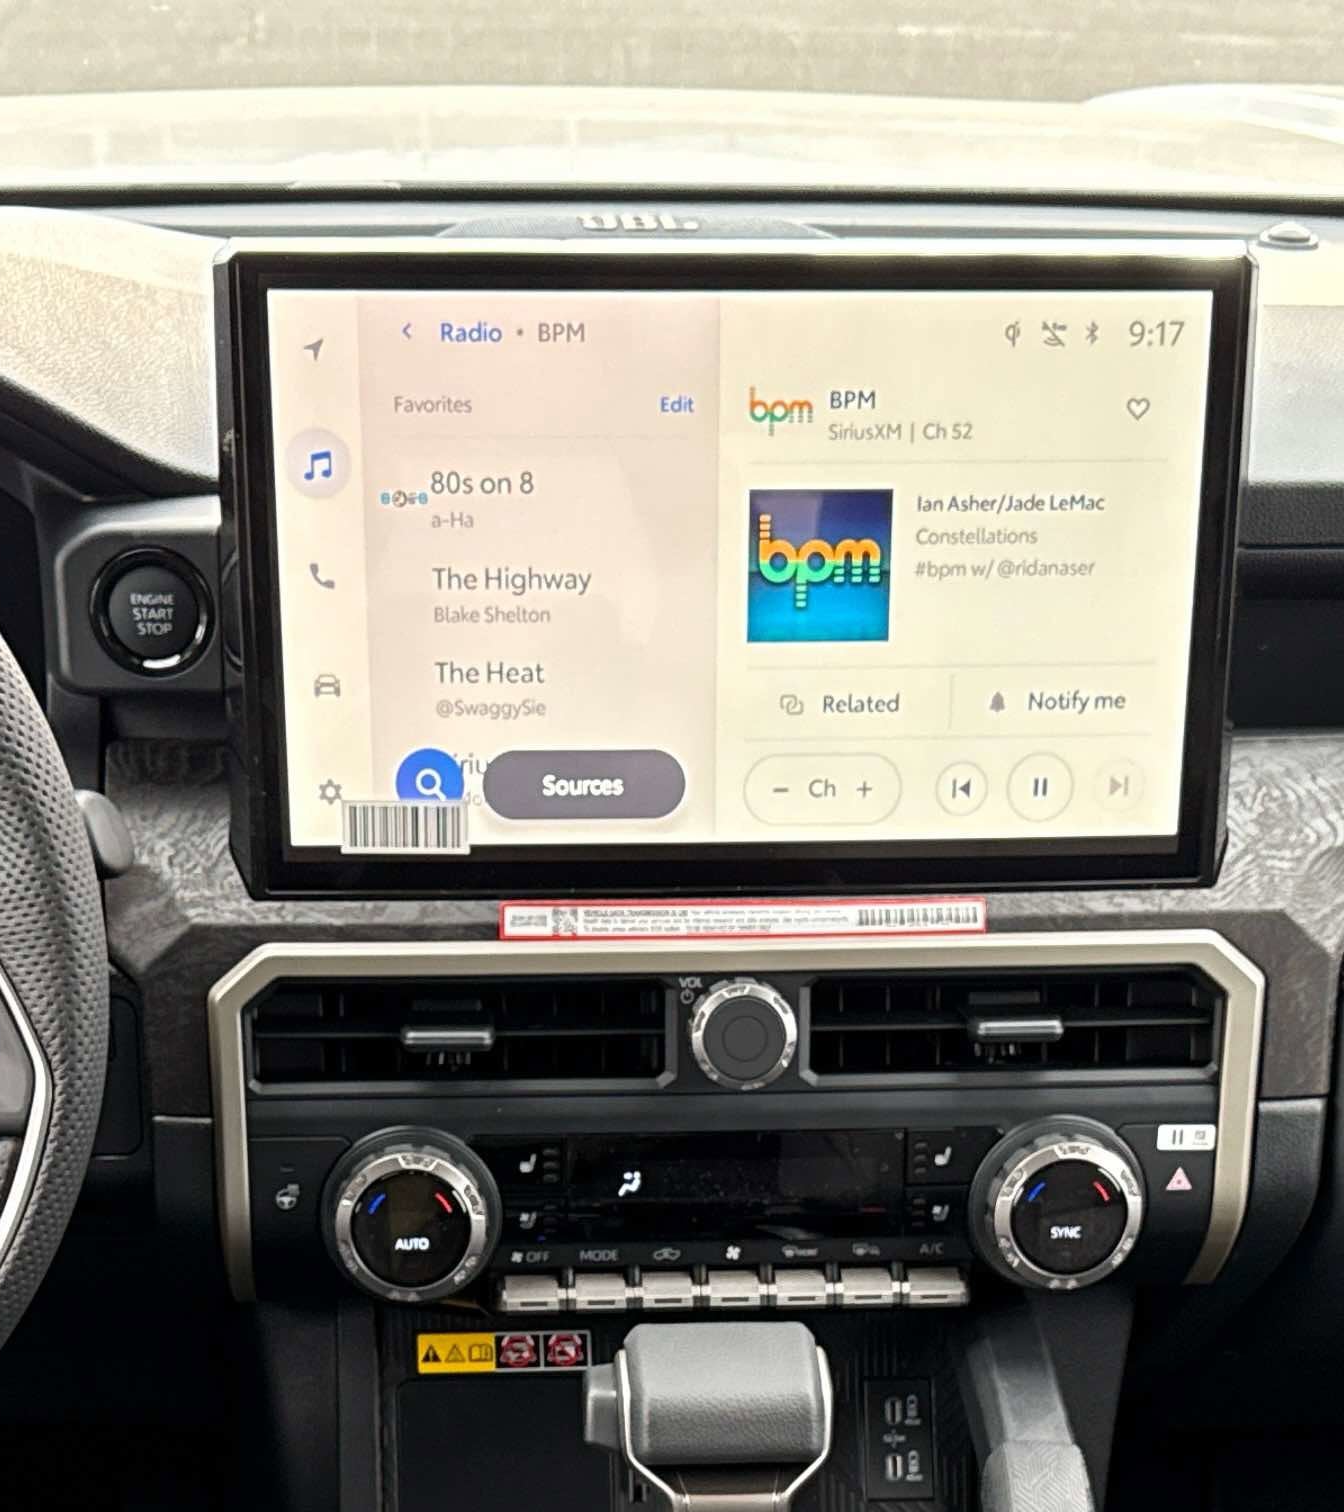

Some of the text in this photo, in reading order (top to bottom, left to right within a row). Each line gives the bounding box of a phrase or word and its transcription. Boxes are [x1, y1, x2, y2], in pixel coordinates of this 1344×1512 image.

[440, 322, 586, 343] Radio BPM
[1128, 321, 1185, 347] 9:17
[393, 395, 473, 415] Favorites
[660, 396, 695, 414] Edit
[829, 390, 877, 410] BPM
[828, 422, 902, 441] SiriusXM
[923, 423, 948, 440] Ch
[951, 423, 973, 440] 52
[430, 470, 535, 495] 80s on 8
[917, 494, 1106, 514] Ian Asher/Jade LeMac
[431, 512, 475, 529] a-Ha
[915, 528, 1038, 545] Constellations
[758, 514, 882, 610] bpm
[915, 560, 1096, 580] #bpm w/ @ridanaser
[432, 568, 592, 597] The Highway
[129, 592, 175, 606] ENGINE
[132, 606, 175, 622] START
[433, 605, 551, 624] Blake Shelton
[136, 621, 174, 636] STOP
[435, 661, 545, 684] The Heat
[435, 699, 547, 719] @SwaggySie
[822, 694, 900, 714] Related
[1027, 693, 1127, 716] Notify me
[541, 775, 625, 797] Sources
[808, 779, 837, 798] Ch
[678, 976, 703, 989] VOL
[1049, 1226, 1082, 1240] SYNC
[394, 1237, 430, 1250] AUTO
[919, 1242, 944, 1256] A/C
[526, 1252, 550, 1263] OFF
[579, 1248, 620, 1262] MODE
